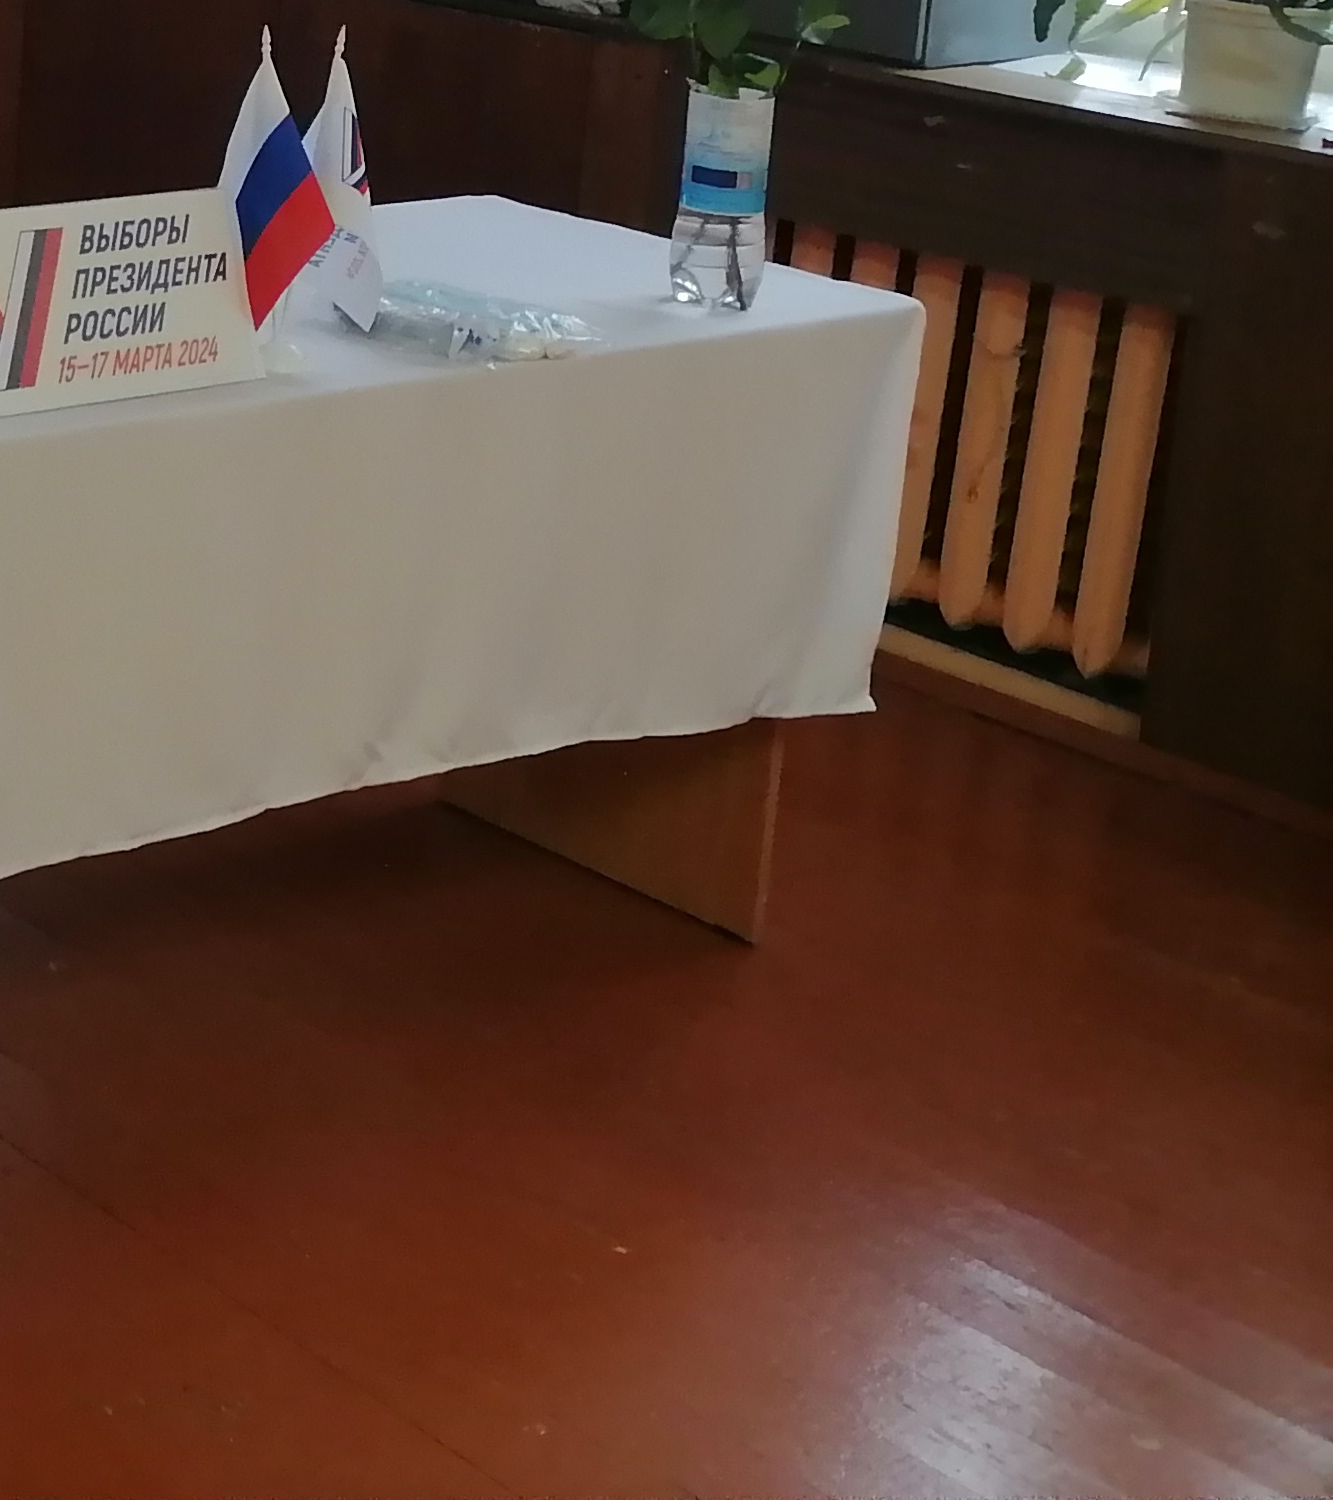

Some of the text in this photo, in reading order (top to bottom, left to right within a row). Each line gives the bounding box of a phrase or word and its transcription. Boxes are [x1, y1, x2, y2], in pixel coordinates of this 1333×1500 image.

[79, 214, 190, 255] ВЫБОРЫ
[72, 252, 228, 300] ПРЕЗИДЕНТА
[63, 301, 166, 345] РОССИИ
[111, 345, 173, 377] МАРТА
[177, 336, 219, 368] 2024
